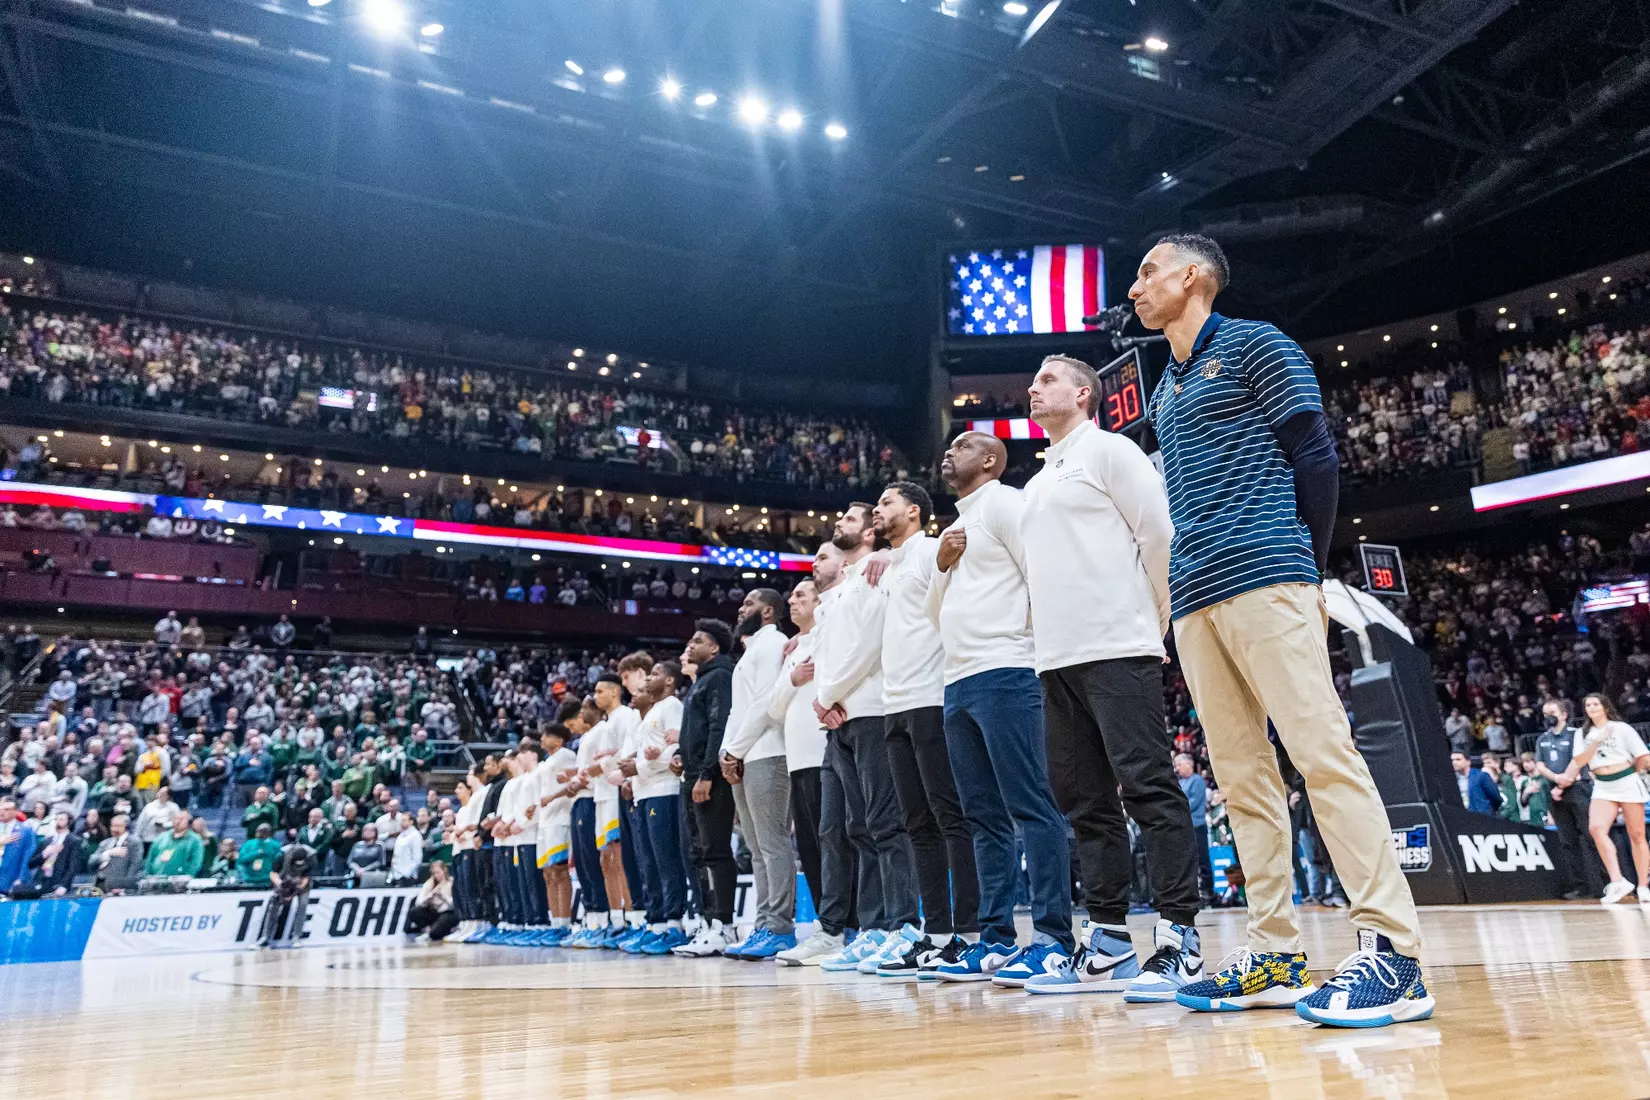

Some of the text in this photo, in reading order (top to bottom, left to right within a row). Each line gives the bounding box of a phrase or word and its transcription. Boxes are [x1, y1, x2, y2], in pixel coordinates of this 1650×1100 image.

[1108, 384, 1140, 430] 30
[1371, 568, 1394, 588] 30
[1457, 834, 1555, 873] NCAA
[122, 915, 194, 933] HOSTED
[197, 914, 222, 930] BY
